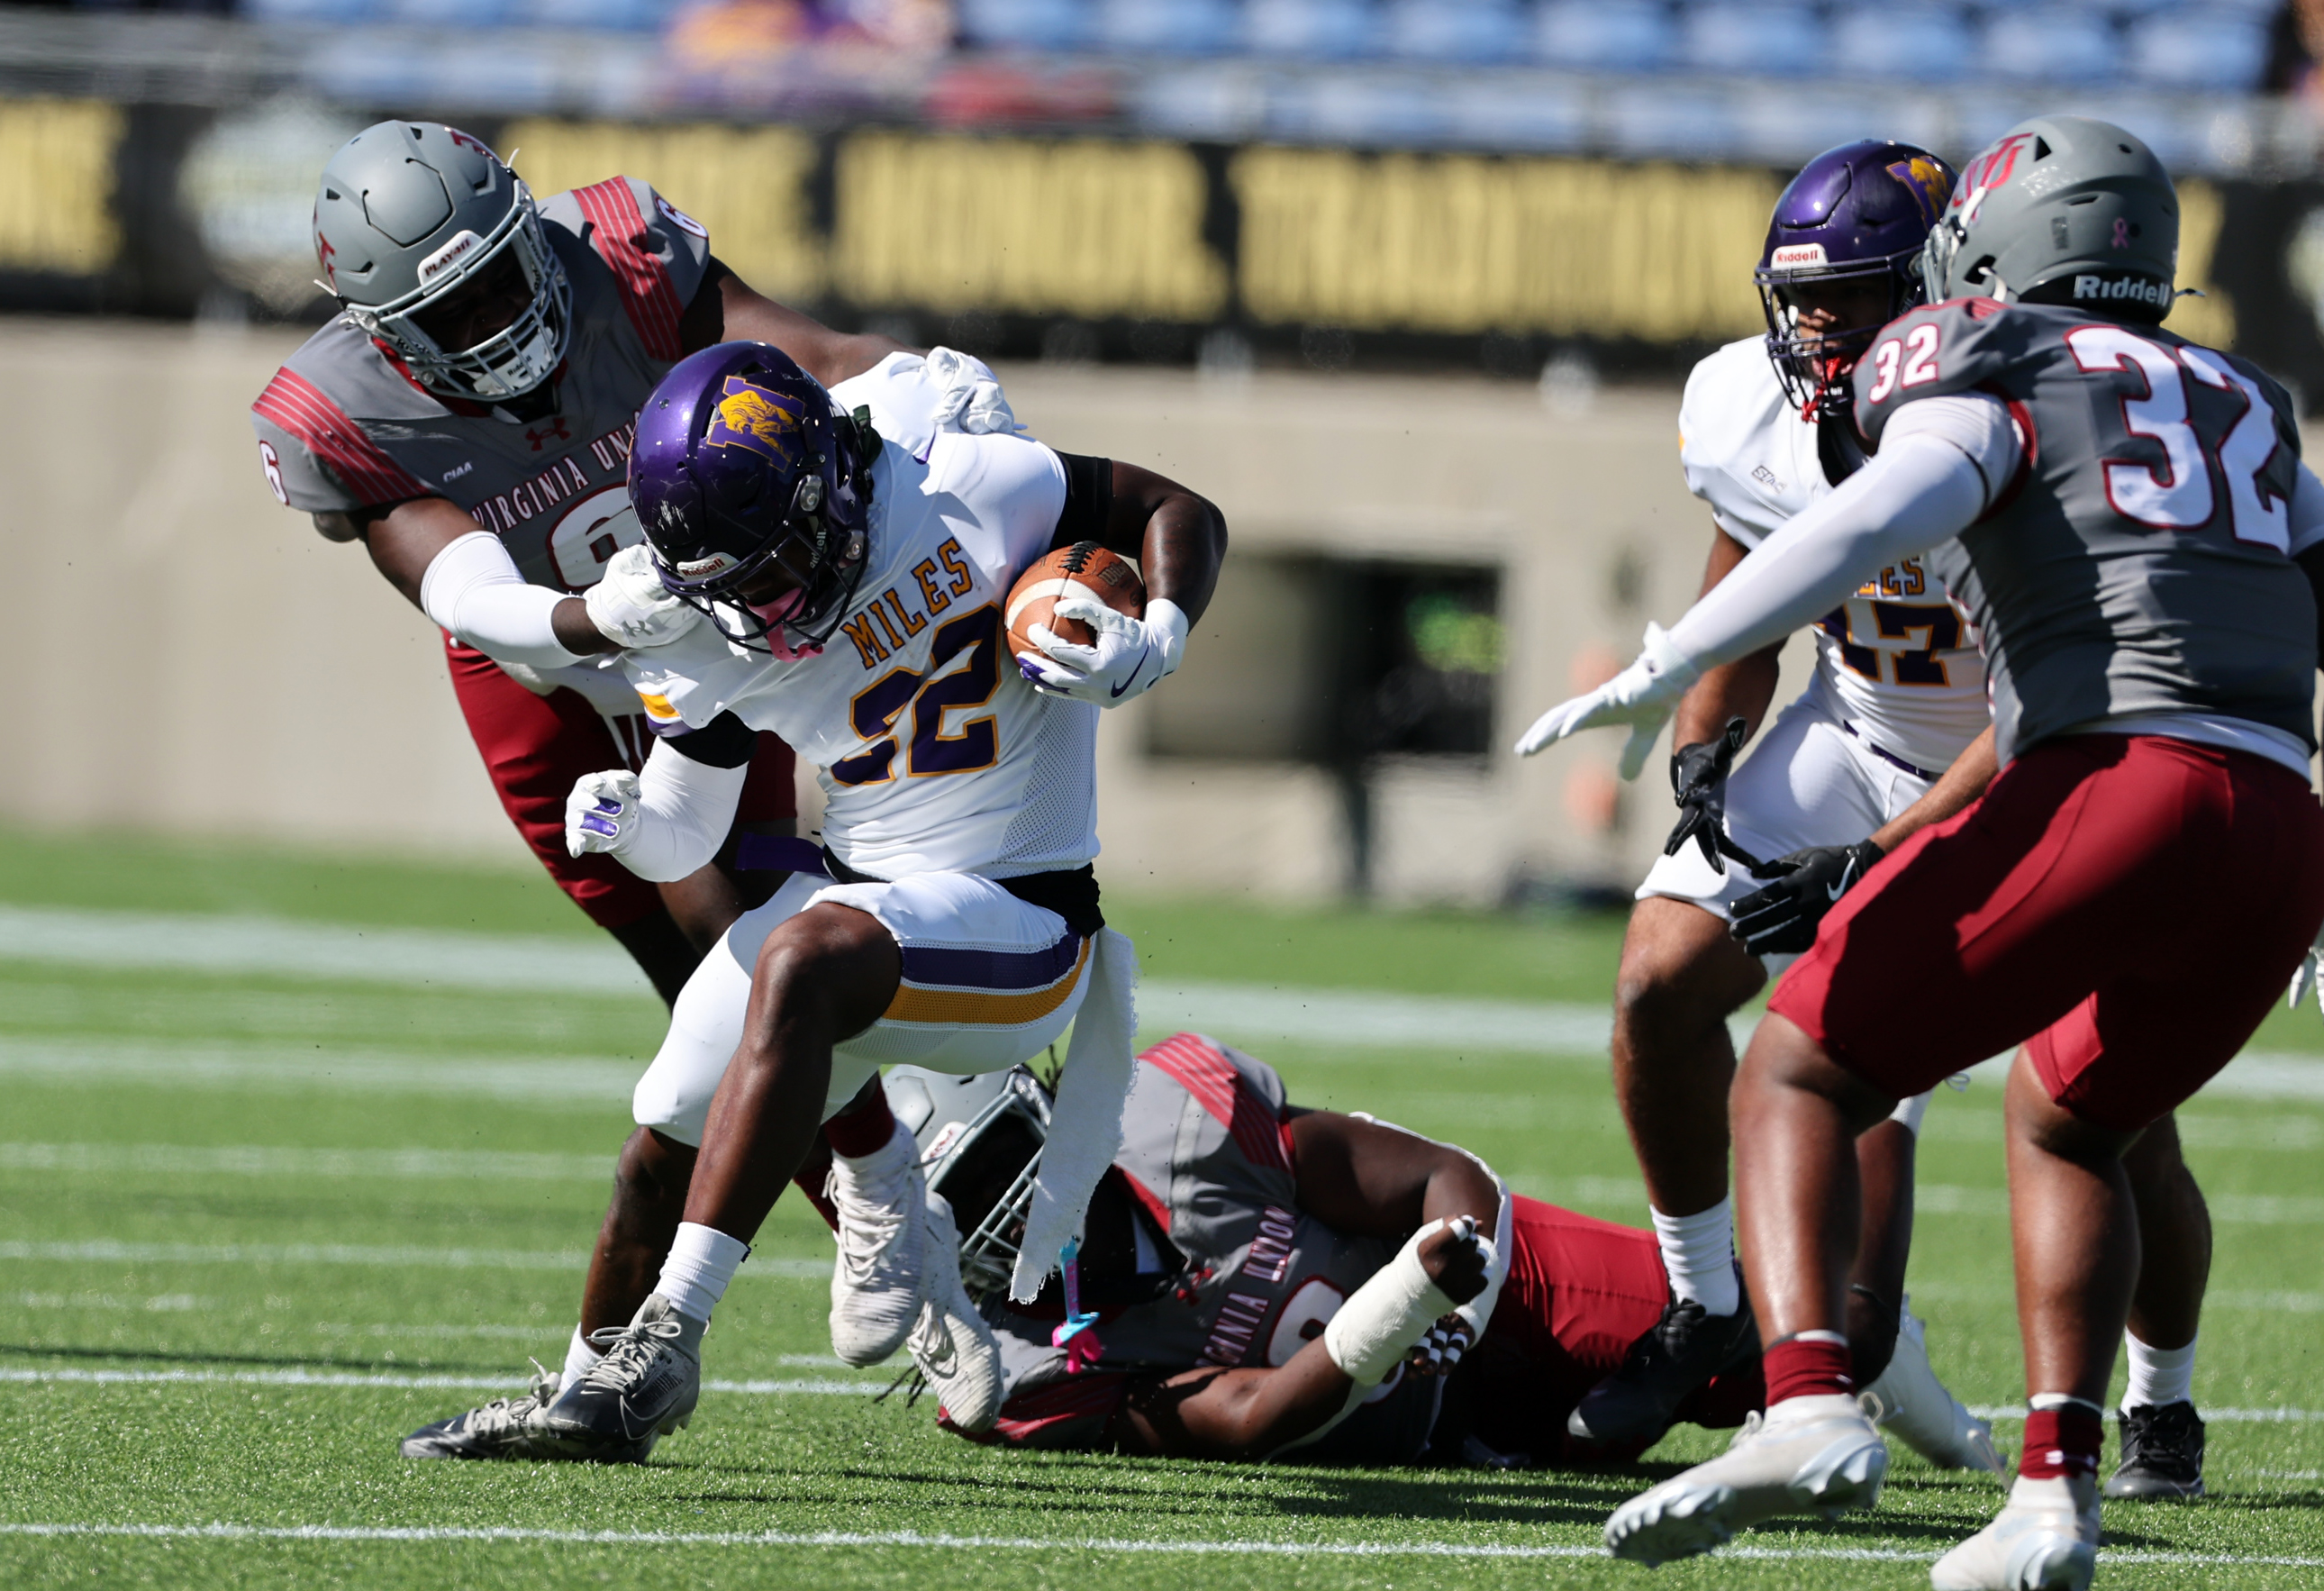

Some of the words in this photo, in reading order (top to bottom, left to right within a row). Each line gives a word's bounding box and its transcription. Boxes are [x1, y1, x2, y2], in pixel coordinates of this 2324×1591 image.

[655, 195, 710, 241] 6
[1775, 250, 1819, 263] Riddell
[2074, 275, 2171, 307] Riddell
[1868, 322, 1940, 405] 32
[259, 440, 290, 506] 6
[2063, 324, 2292, 557] 32
[470, 454, 591, 536] VIRGINIA
[681, 556, 725, 577] Riddell
[840, 536, 973, 670] MILES
[1242, 1205, 1296, 1283] UNION
